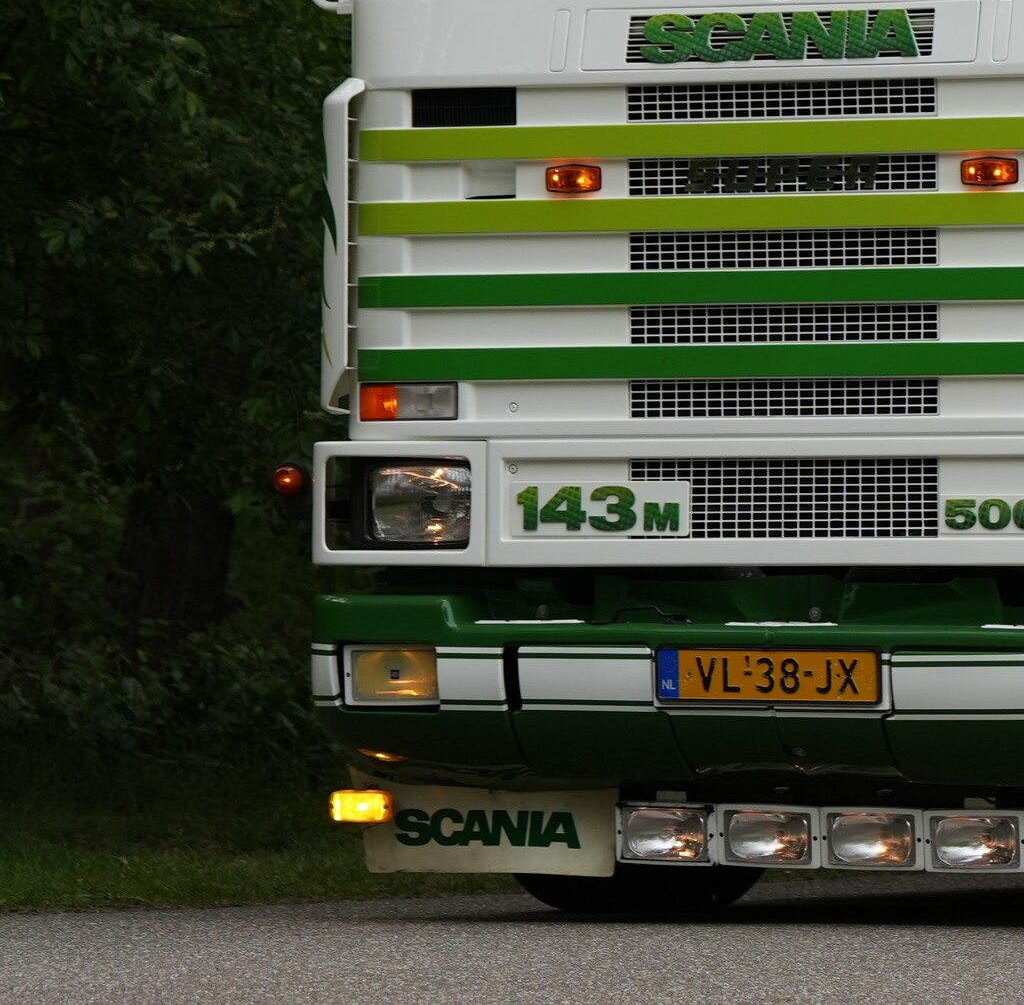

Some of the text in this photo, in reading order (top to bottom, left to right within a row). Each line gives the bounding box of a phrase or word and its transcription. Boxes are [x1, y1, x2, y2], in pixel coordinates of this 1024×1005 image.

[639, 8, 920, 64] SCANIA
[684, 154, 879, 193] SUPER
[661, 679, 677, 691] NL
[695, 656, 860, 695] VL-38-JX
[394, 807, 582, 850] SCANIA
